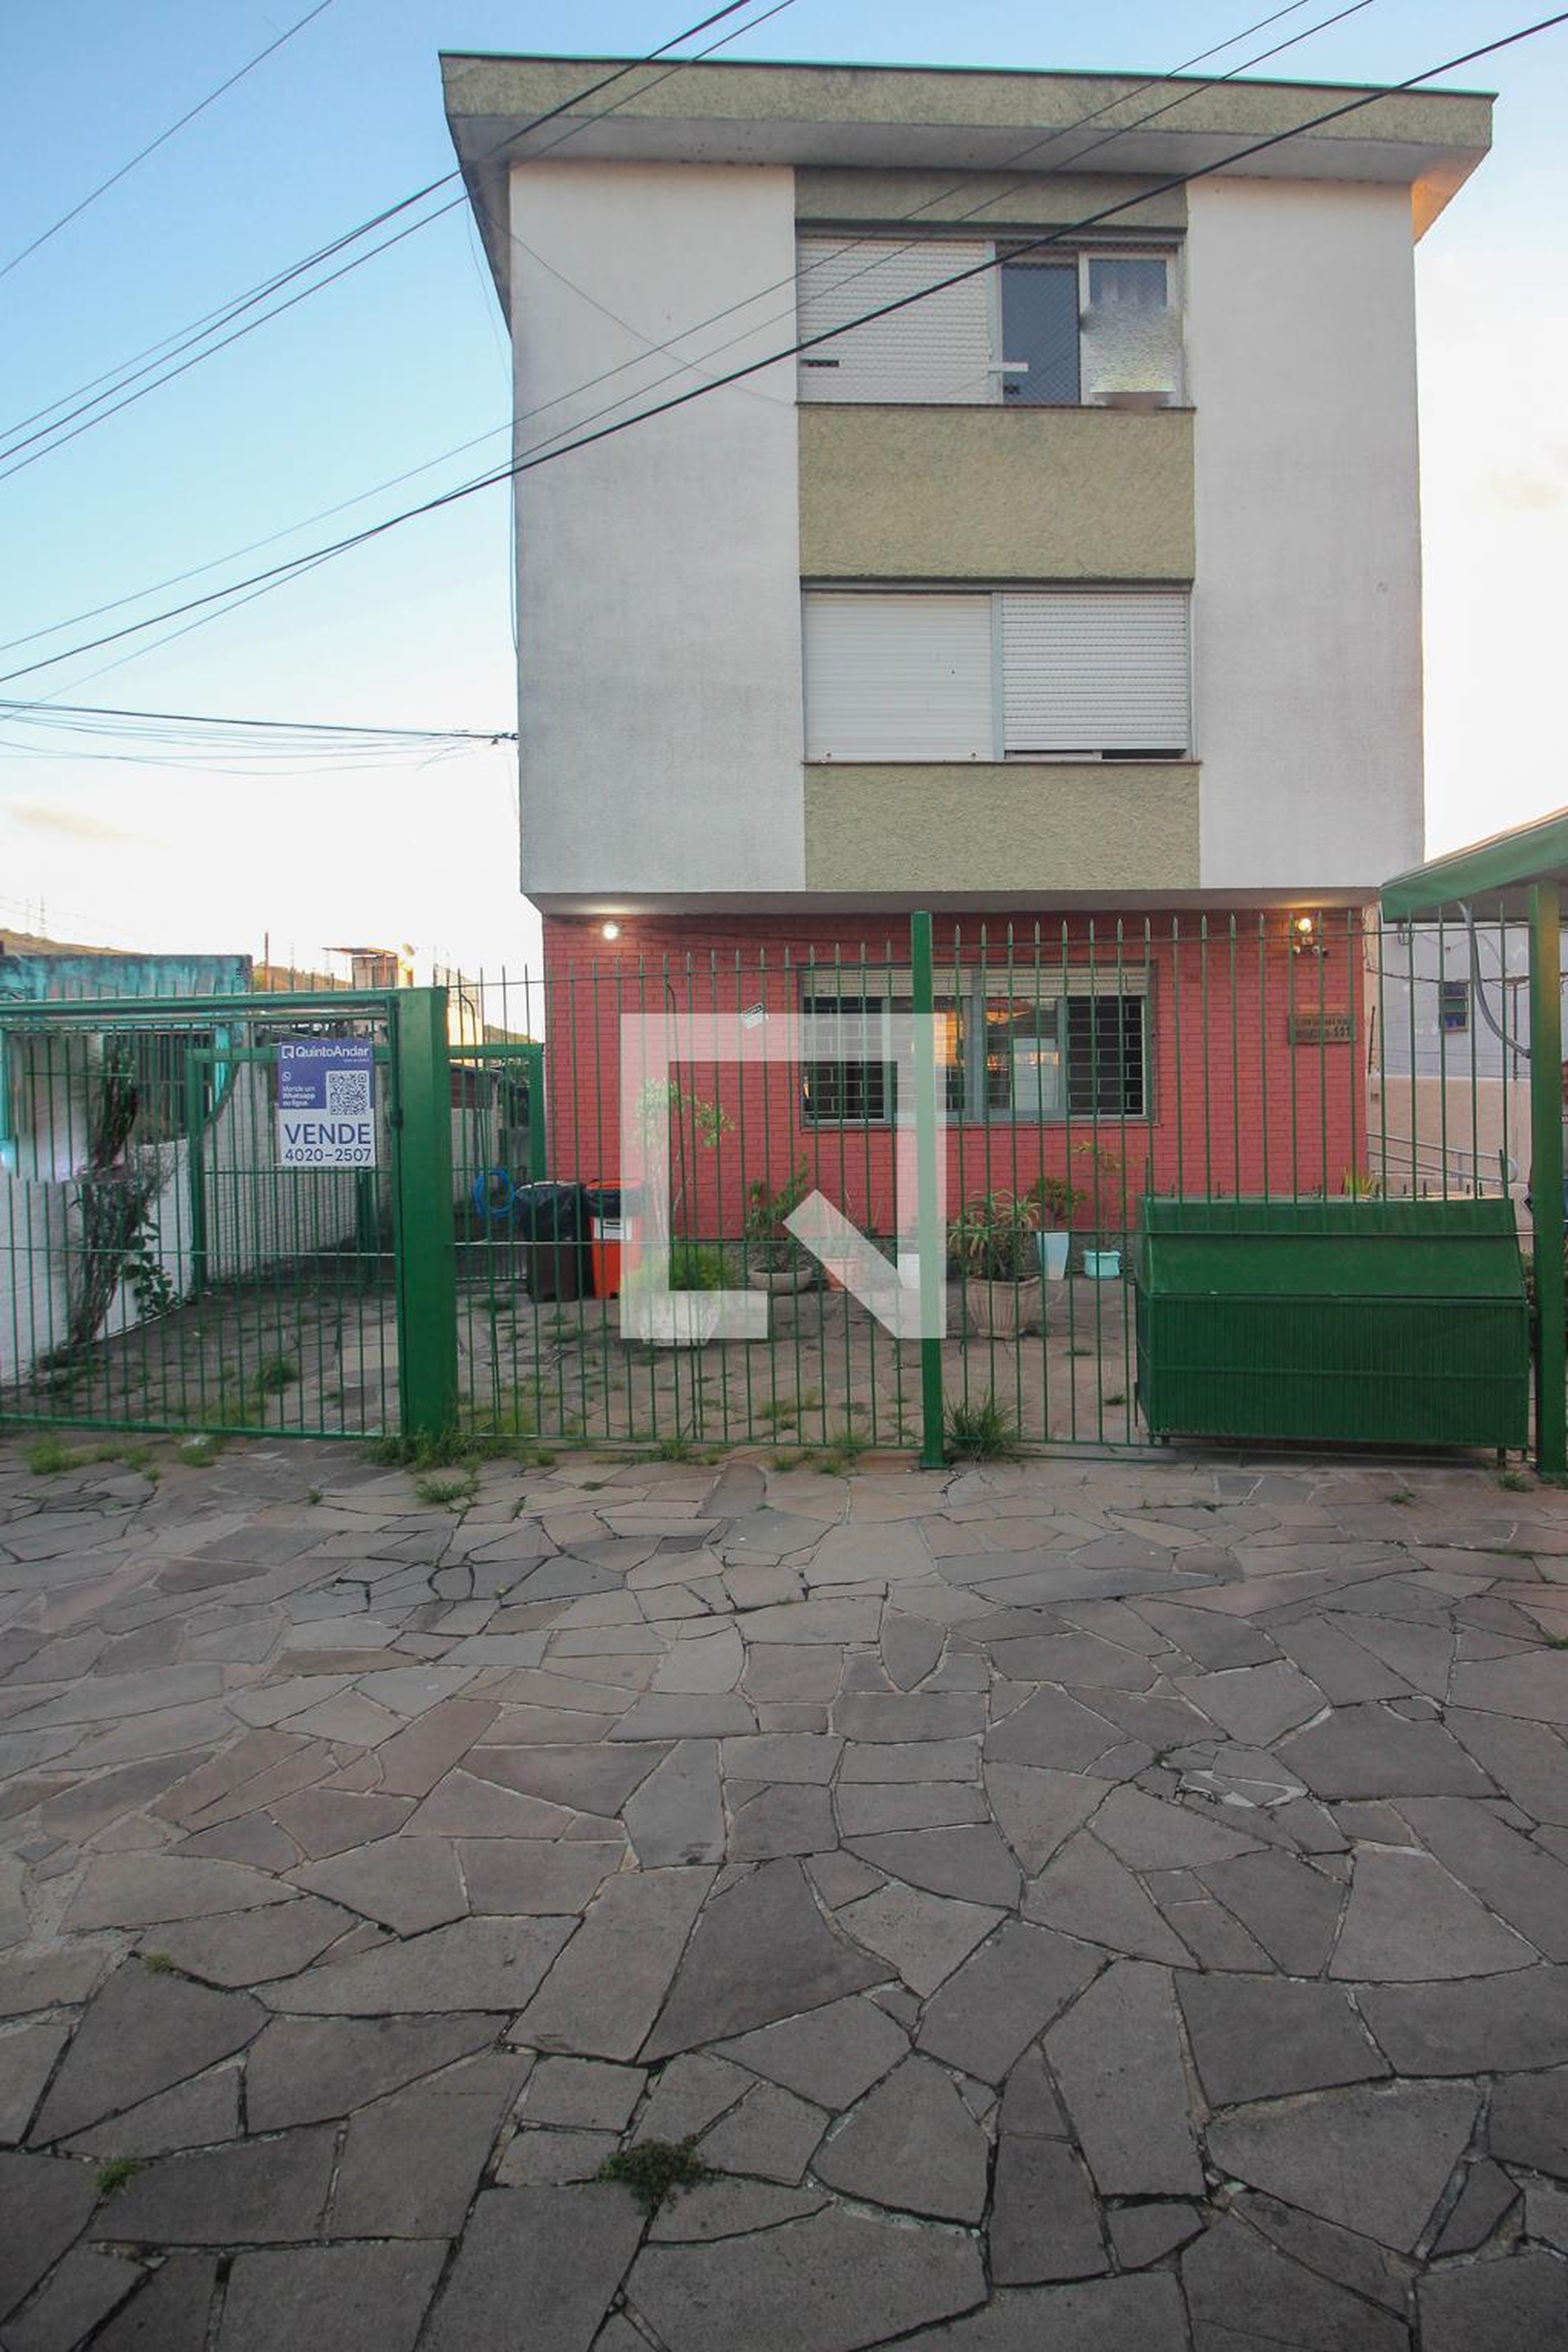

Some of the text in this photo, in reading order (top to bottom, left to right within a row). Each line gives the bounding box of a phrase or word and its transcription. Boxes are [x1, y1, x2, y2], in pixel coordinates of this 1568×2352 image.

[296, 1045, 369, 1057] QuintoAndar
[284, 1123, 371, 1144] VENDE
[285, 1148, 371, 1162] 4020-2507
